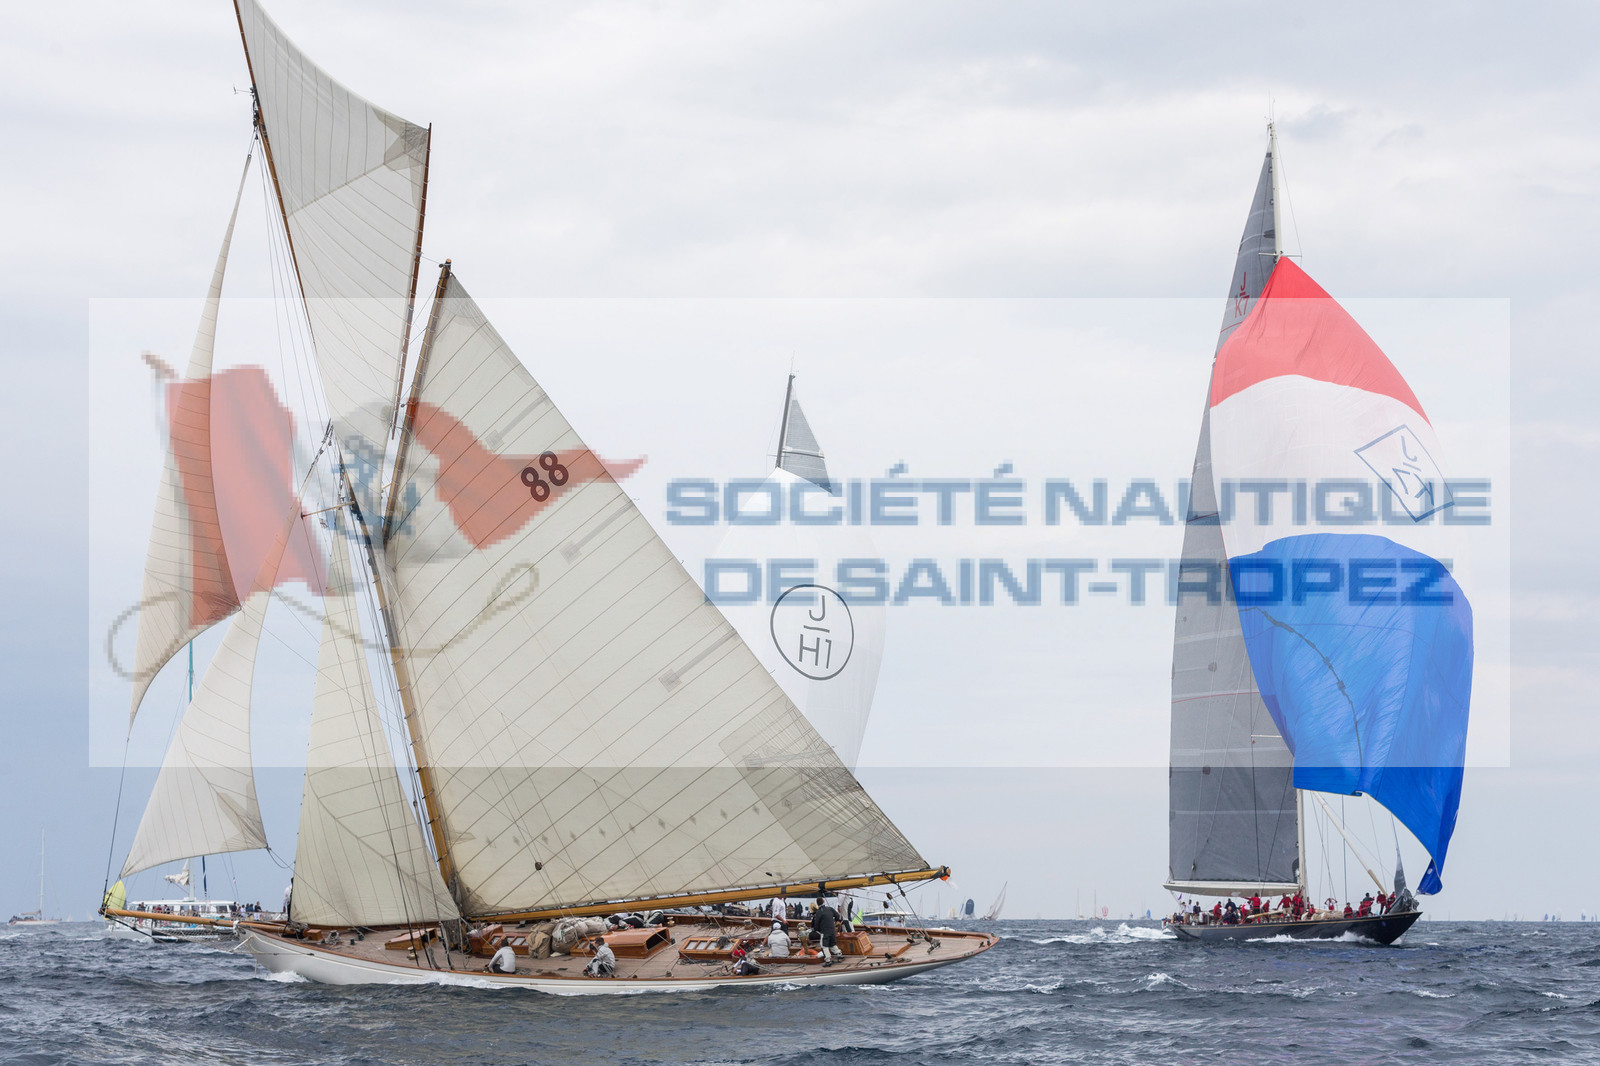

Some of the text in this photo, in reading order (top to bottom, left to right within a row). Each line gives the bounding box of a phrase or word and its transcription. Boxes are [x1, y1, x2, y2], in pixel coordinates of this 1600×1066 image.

[1240, 271, 1247, 292] J
[1234, 294, 1250, 318] K7
[520, 450, 569, 502] 88
[808, 594, 826, 622] J
[798, 633, 832, 669] H1
